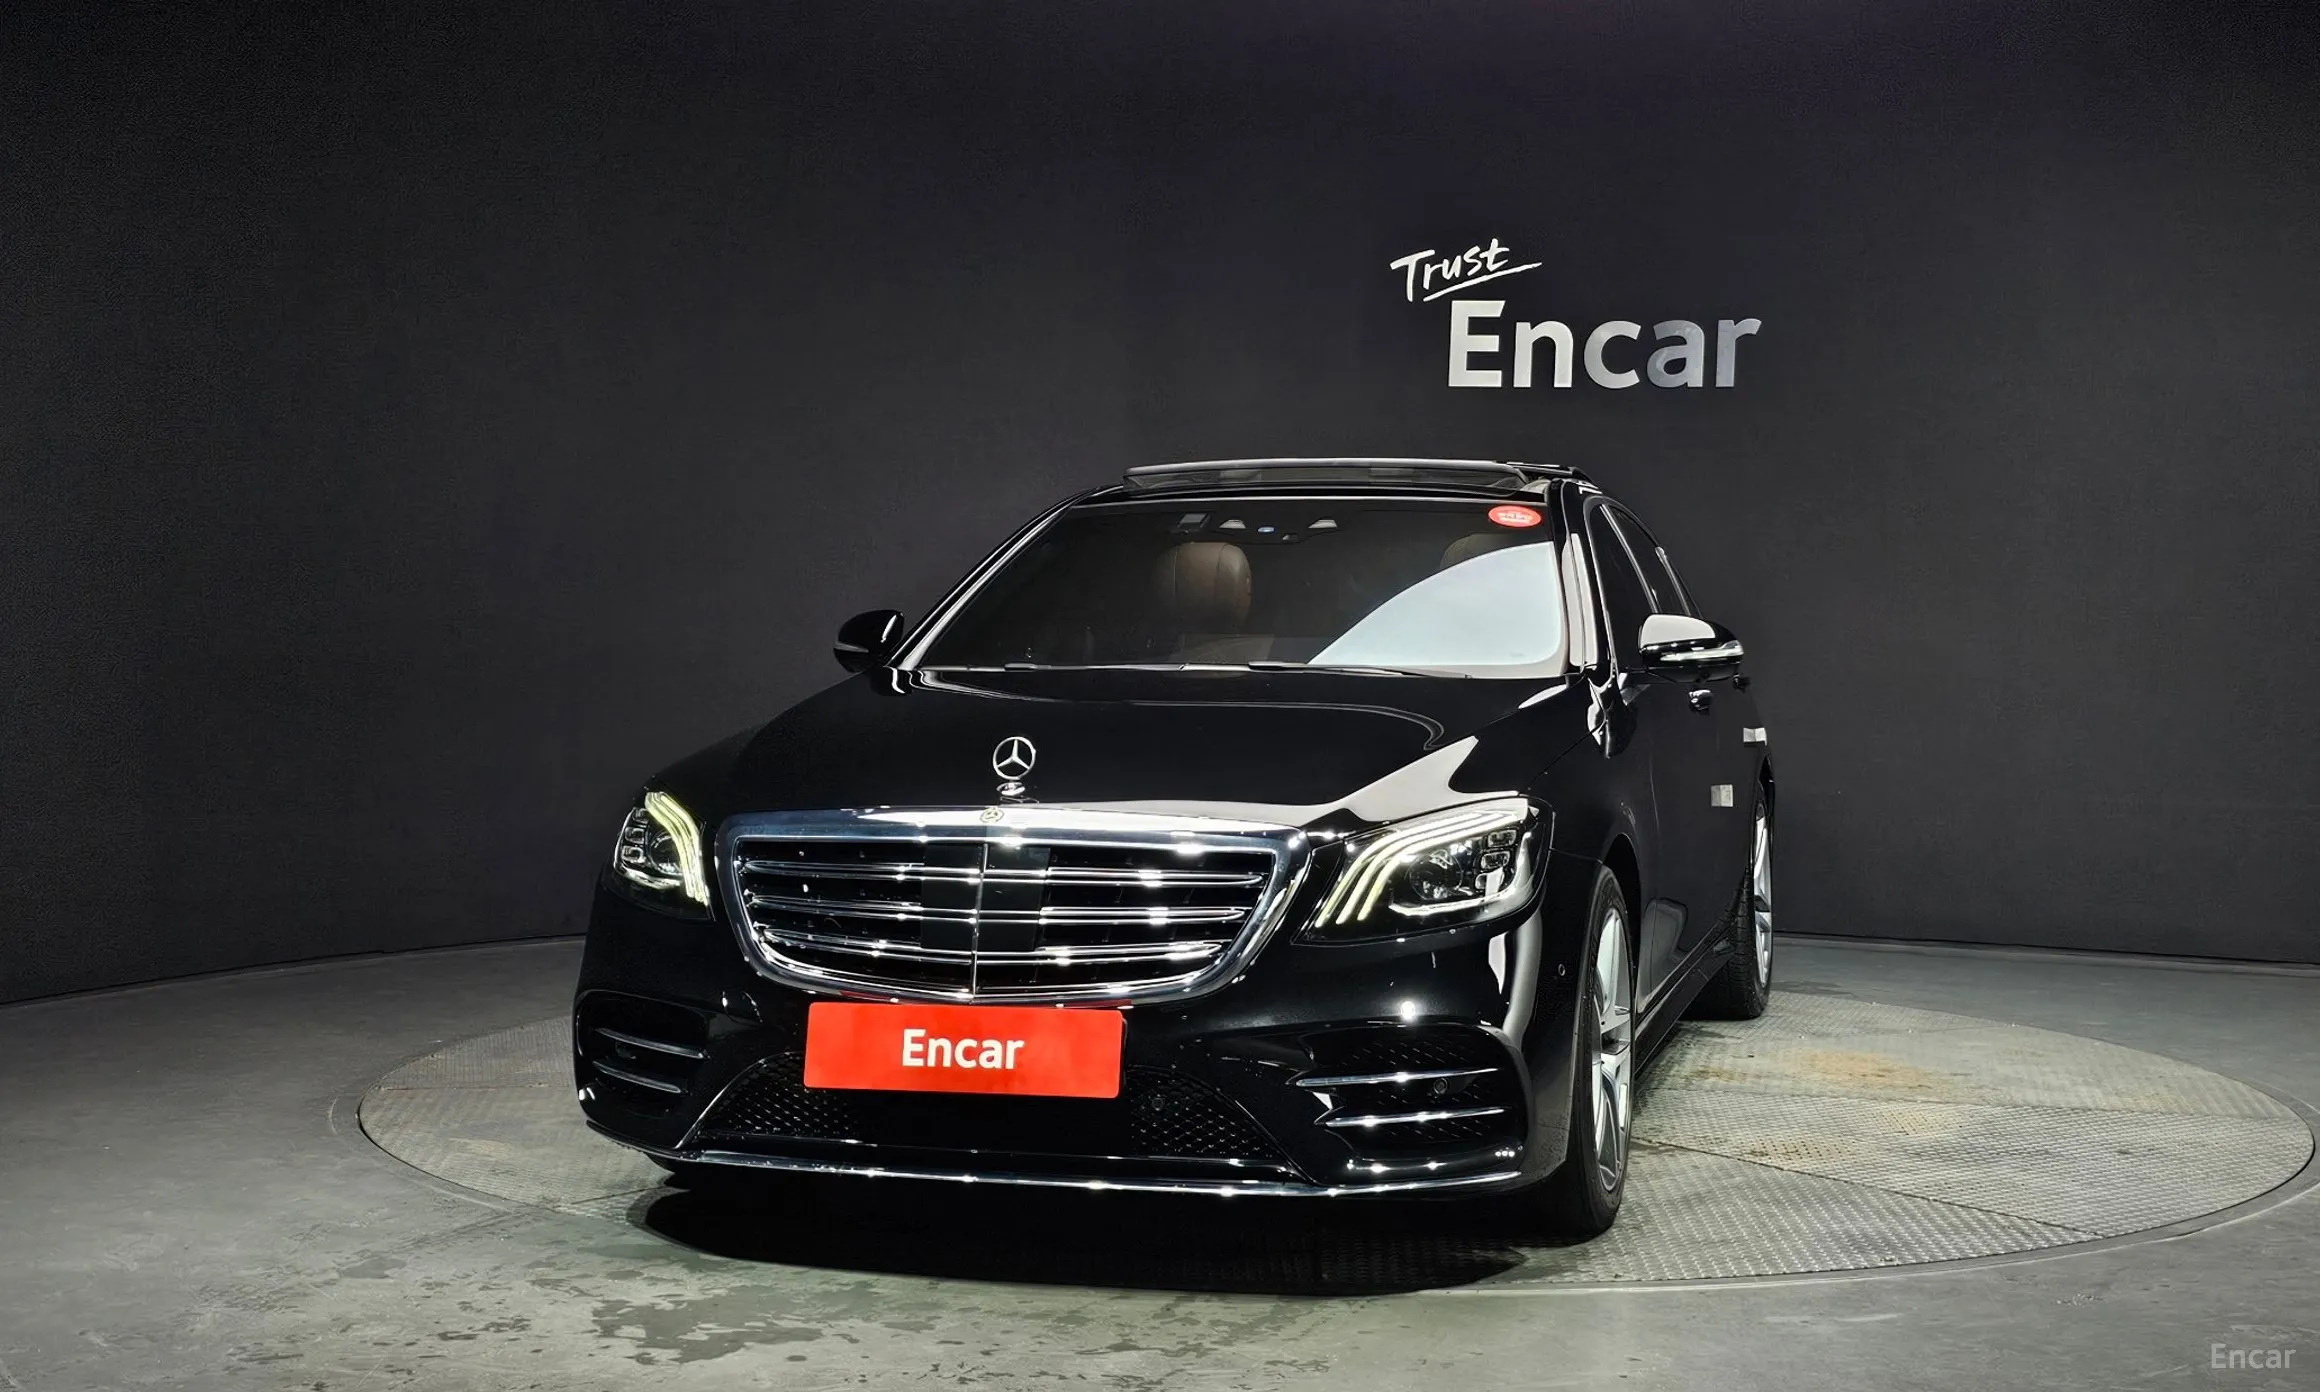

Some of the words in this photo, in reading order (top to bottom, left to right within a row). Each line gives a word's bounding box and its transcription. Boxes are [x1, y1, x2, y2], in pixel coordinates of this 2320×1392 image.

[1390, 238, 1511, 302] Trust
[1448, 300, 1762, 389] Encar
[902, 1028, 1025, 1070] Encar
